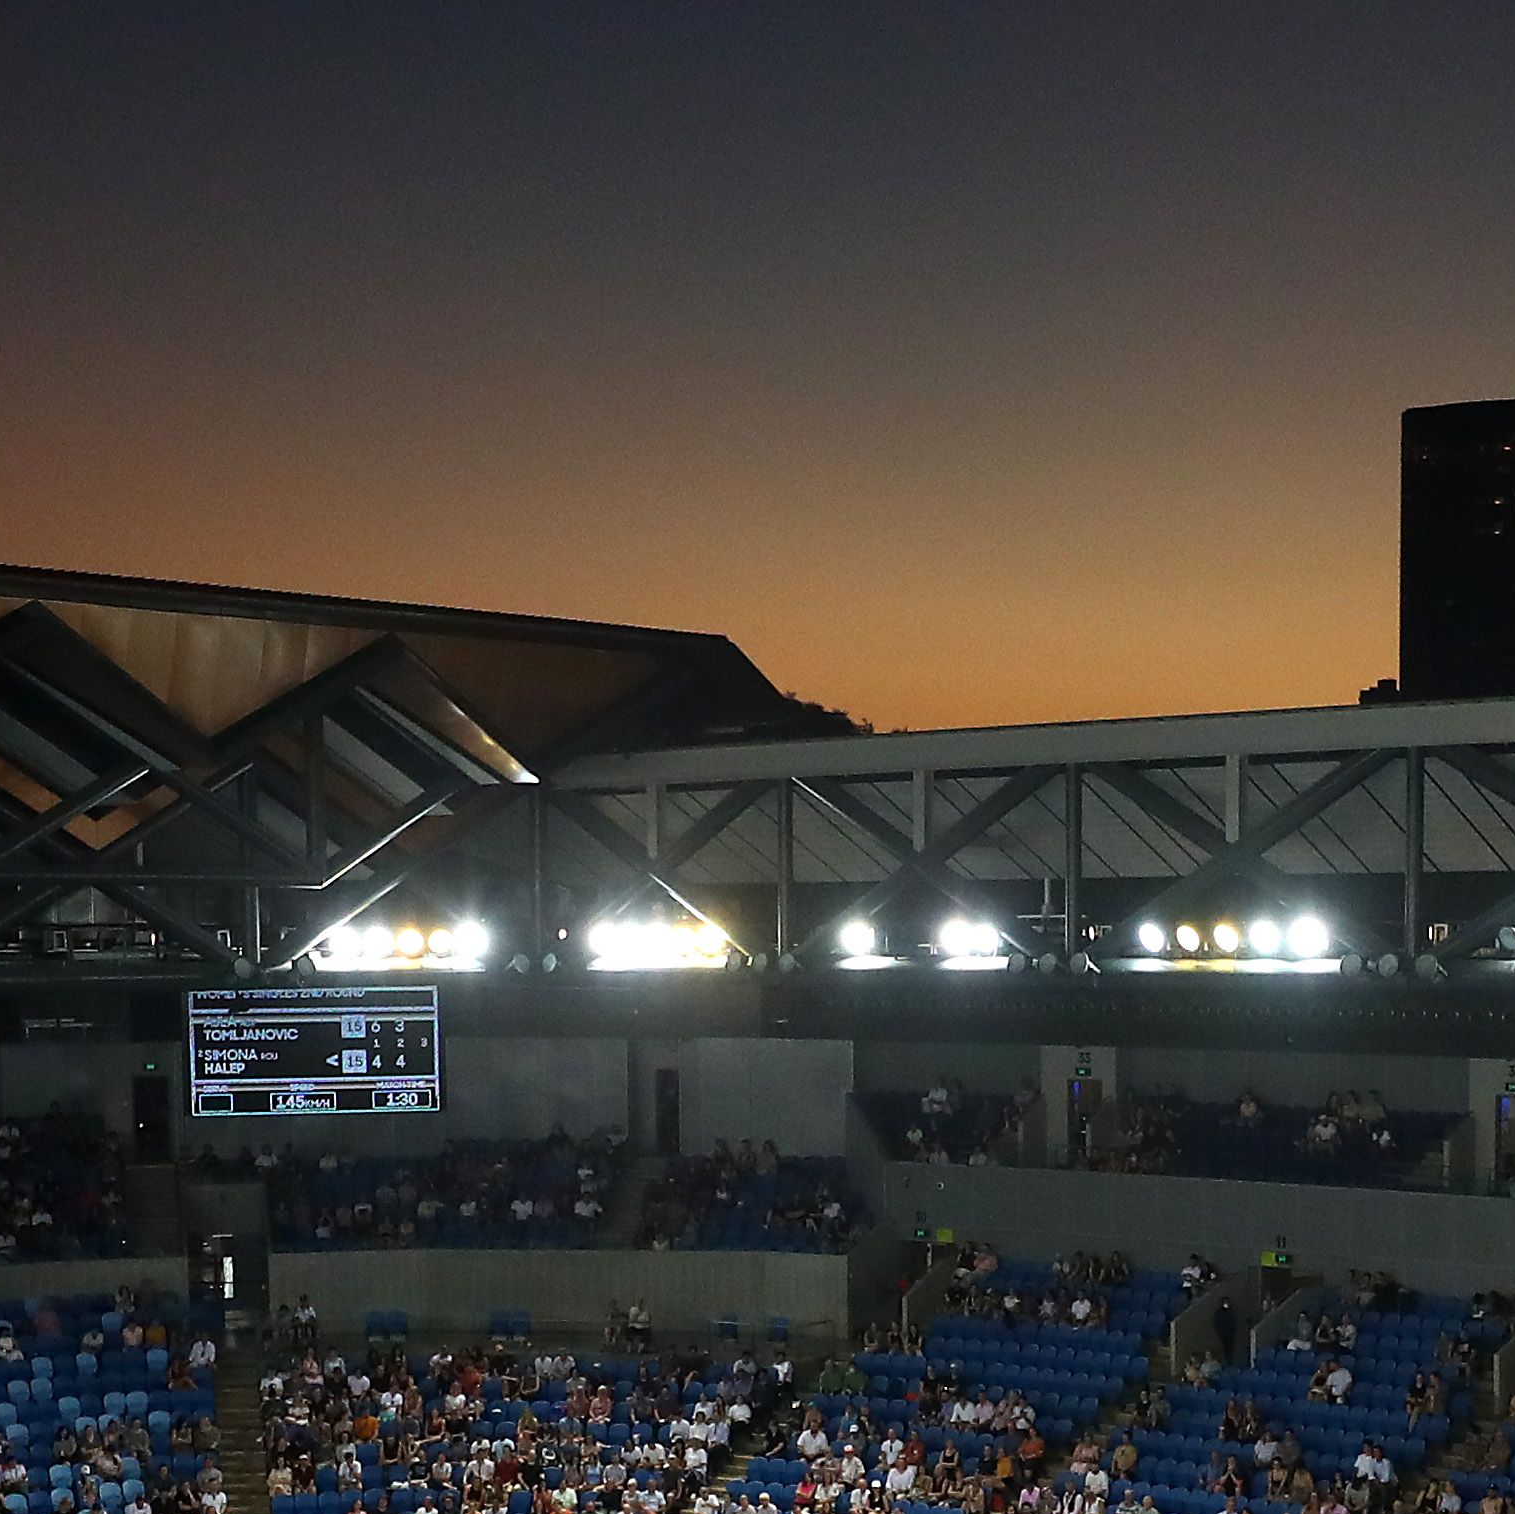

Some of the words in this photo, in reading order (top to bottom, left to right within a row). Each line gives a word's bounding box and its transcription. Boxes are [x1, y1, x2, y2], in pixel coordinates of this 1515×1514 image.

[371, 1021, 380, 1033] 6
[395, 1019, 405, 1033] 3
[203, 1029, 299, 1041] TOMLJANOVIC
[373, 1038, 380, 1048] 1
[397, 1038, 405, 1048] 2
[421, 1037, 428, 1047] 3
[204, 1049, 258, 1061] SIMONA
[371, 1055, 382, 1068] 4
[395, 1055, 406, 1067] 4
[204, 1063, 246, 1074] HALEP
[386, 1093, 418, 1106] 1:30
